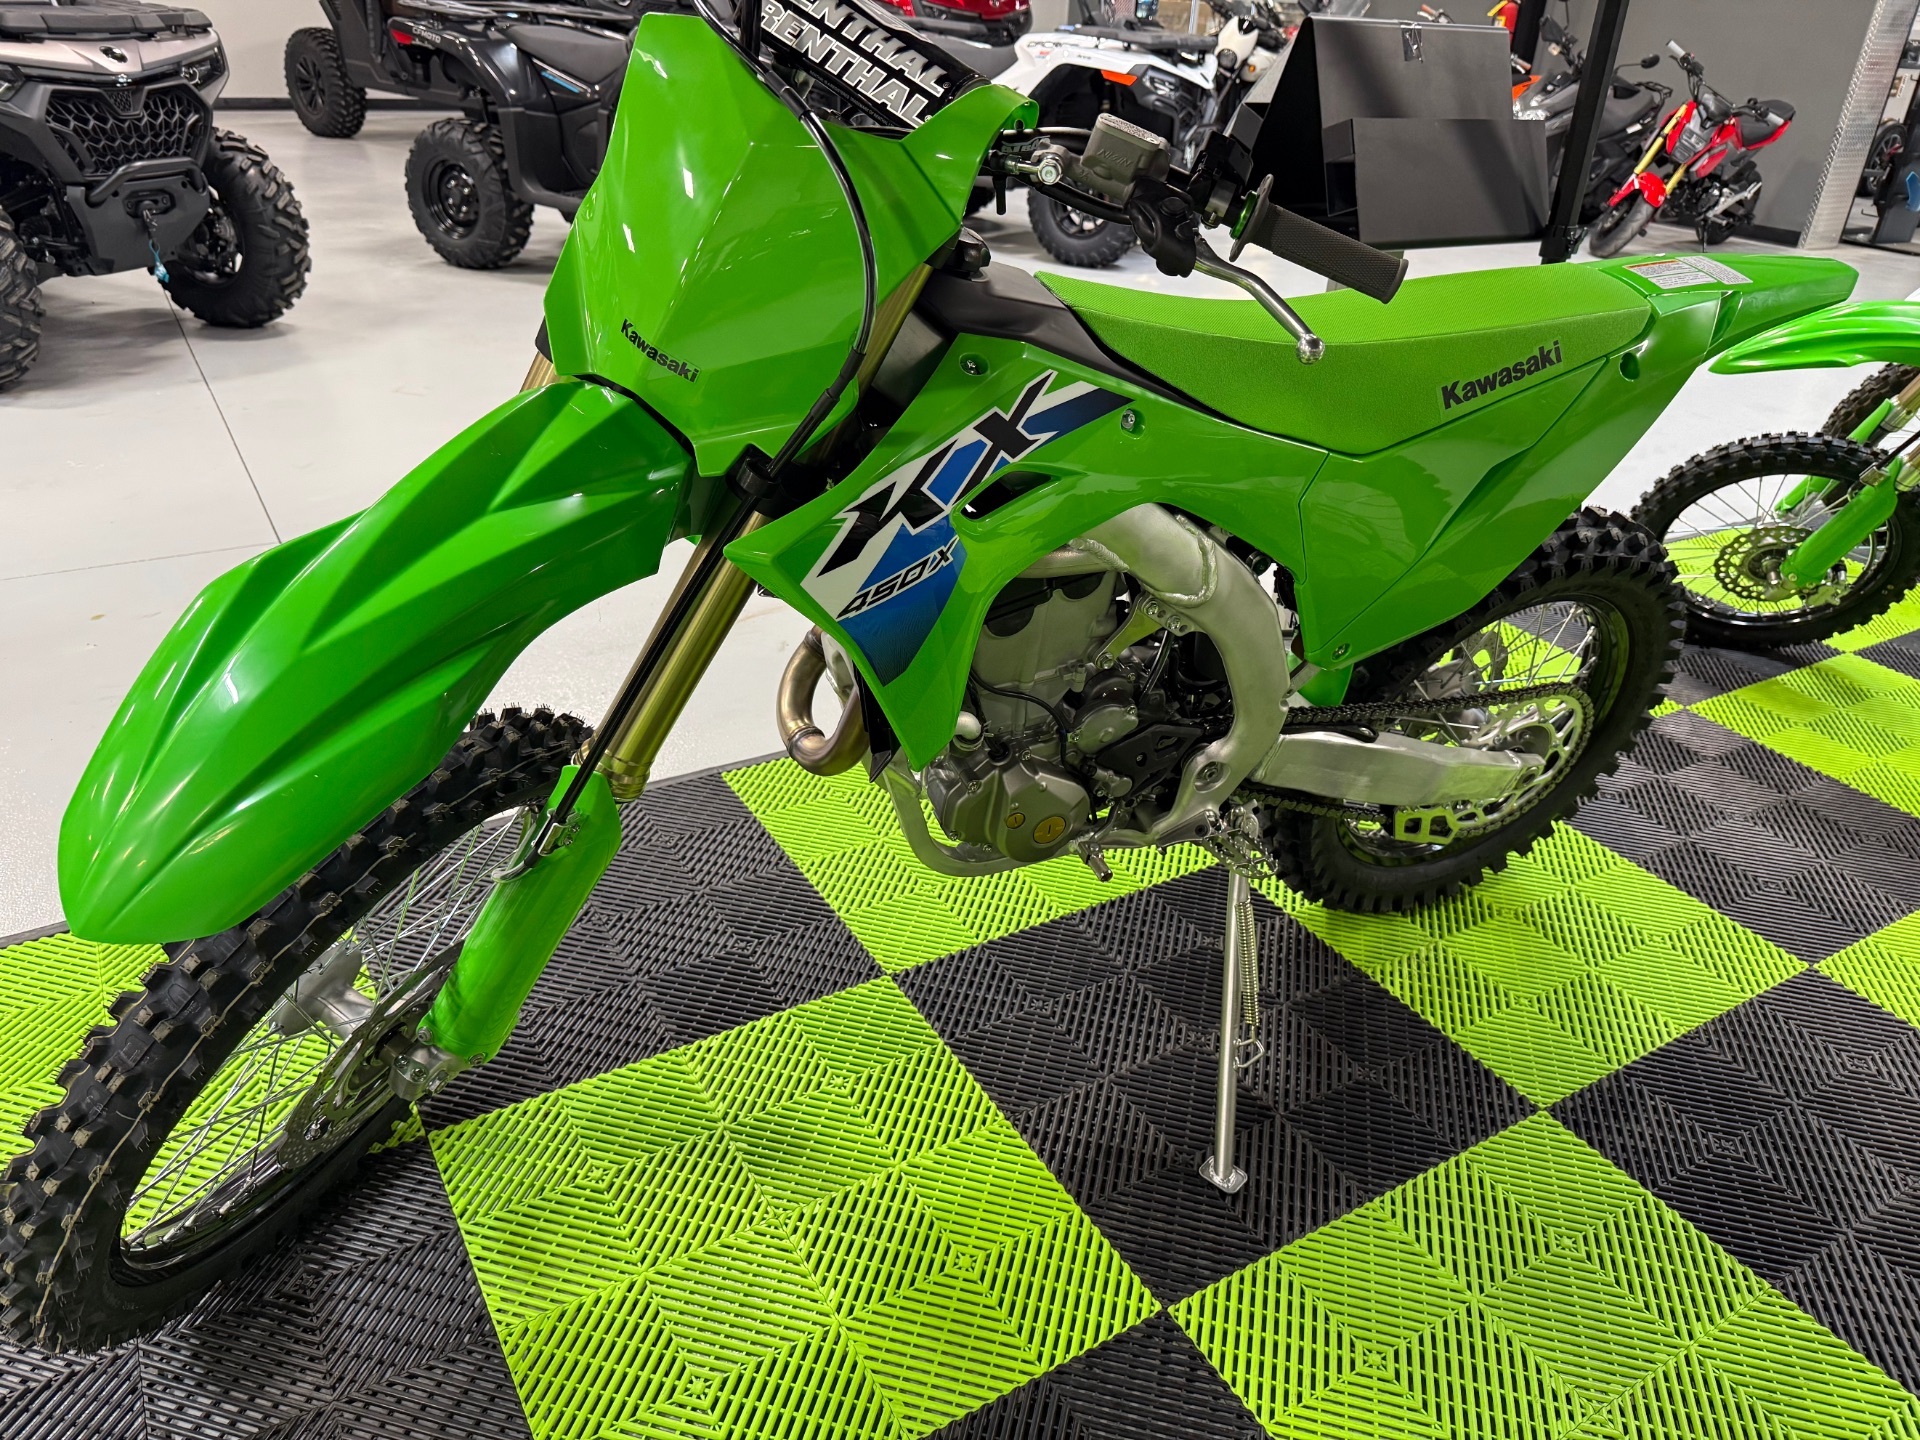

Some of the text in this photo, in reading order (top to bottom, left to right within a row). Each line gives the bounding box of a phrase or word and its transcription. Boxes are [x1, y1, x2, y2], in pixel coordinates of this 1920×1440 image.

[761, 0, 928, 128] RENTHAL
[621, 318, 699, 383] Kawasaki
[1441, 339, 1562, 410] Kawasaki
[816, 370, 1057, 579] KX
[836, 536, 958, 620] 450X
